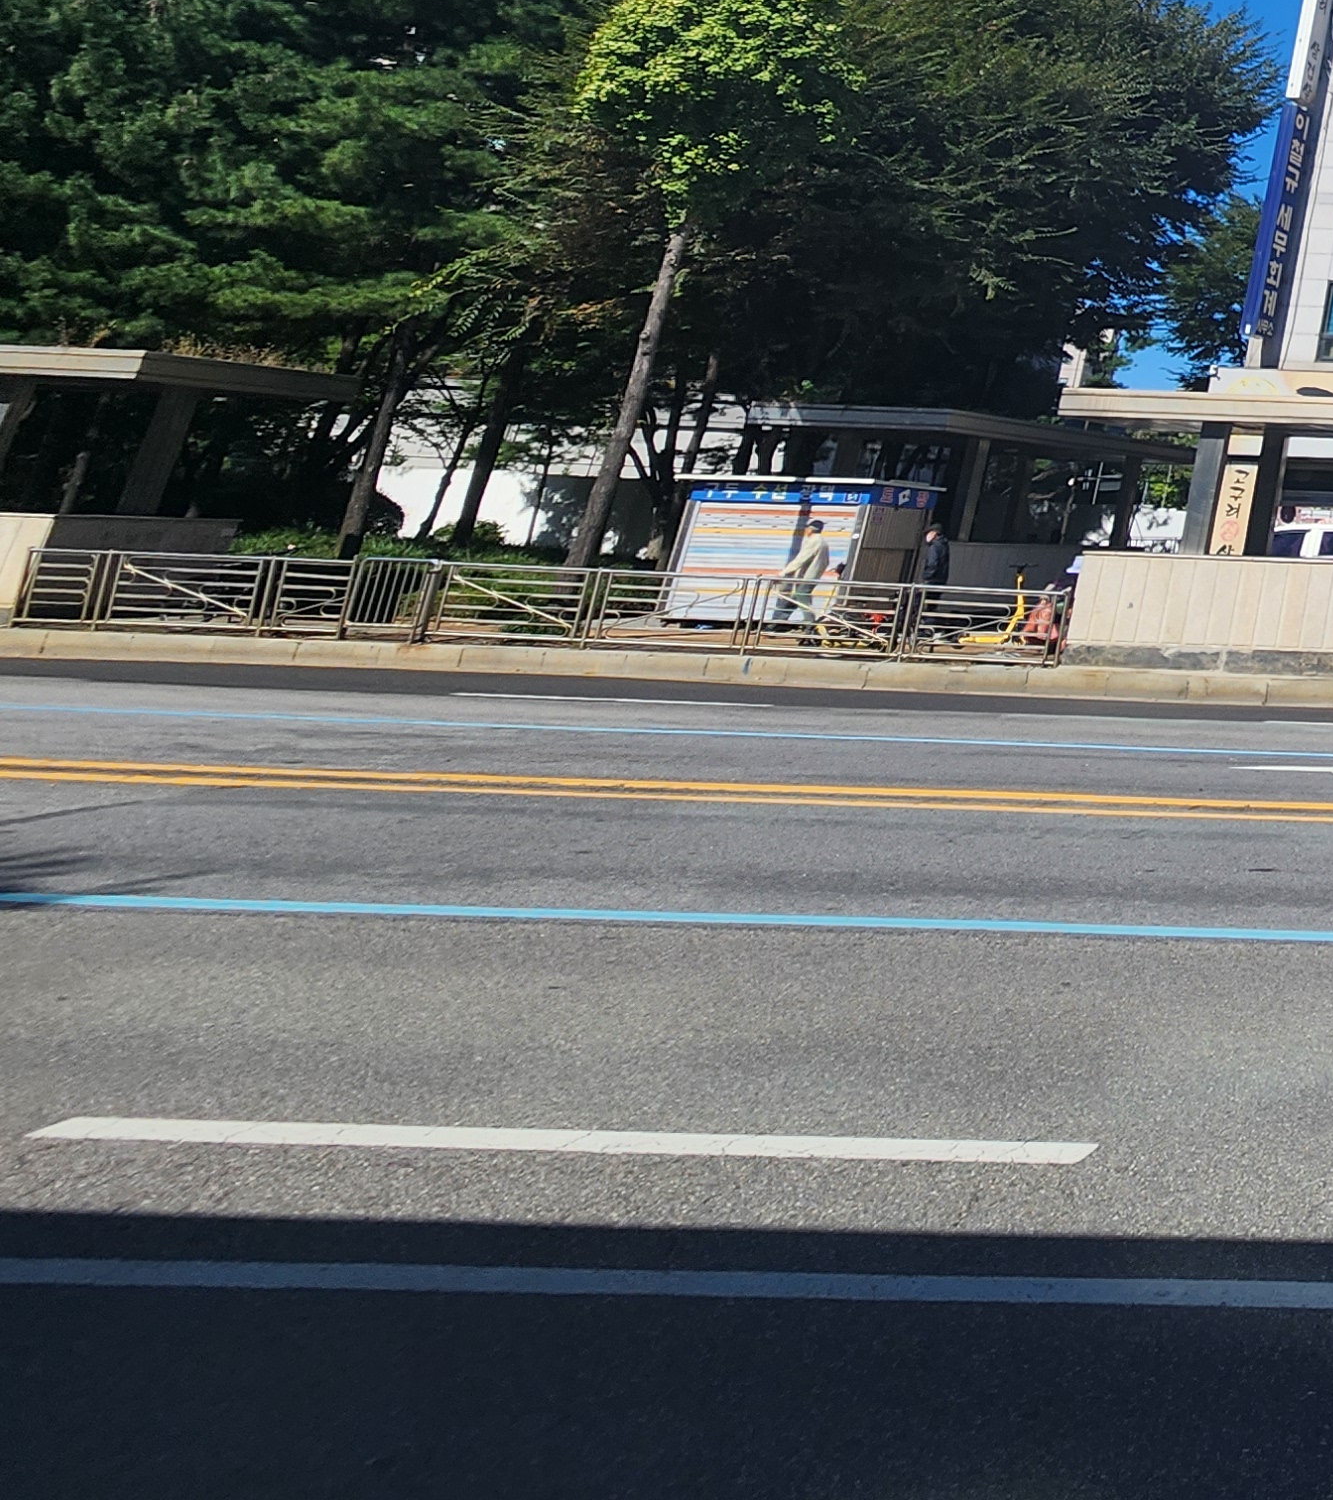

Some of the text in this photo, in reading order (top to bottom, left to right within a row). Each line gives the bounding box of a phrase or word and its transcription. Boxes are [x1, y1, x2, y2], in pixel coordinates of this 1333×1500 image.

[1285, 112, 1311, 195] 이철규
[1263, 203, 1294, 317] 세무회계
[704, 483, 739, 498] 구두
[754, 484, 788, 500] 수선
[1225, 470, 1249, 519] 고구려
